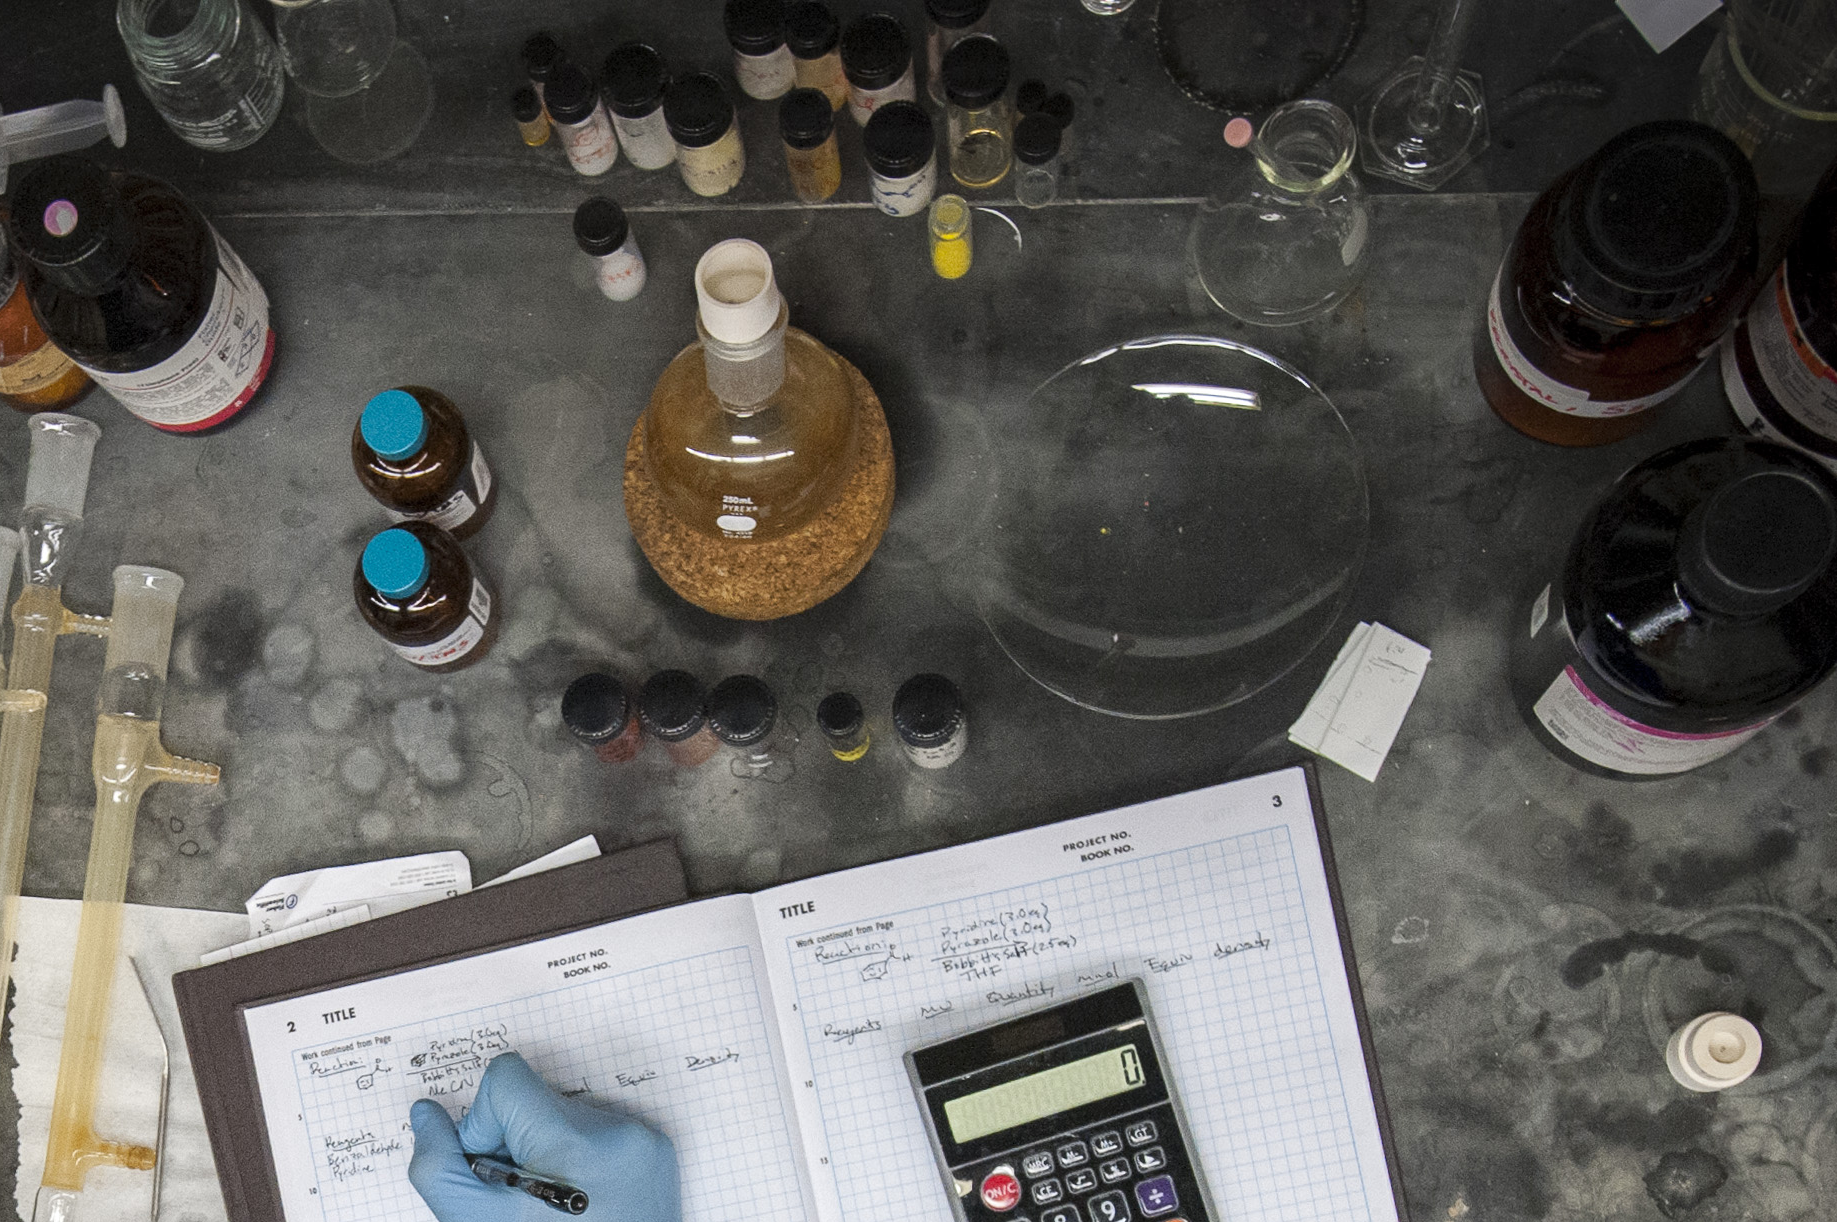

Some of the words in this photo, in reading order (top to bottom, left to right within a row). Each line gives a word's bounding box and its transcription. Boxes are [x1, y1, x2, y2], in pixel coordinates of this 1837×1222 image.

[1272, 795, 1283, 808] 3
[1062, 835, 1107, 852] PROJECT
[1110, 830, 1132, 842] NO.
[1080, 848, 1111, 863] BOOK
[1114, 844, 1135, 856] NO.
[779, 901, 816, 920] TITLE
[795, 937, 815, 948] Work
[816, 928, 854, 944] continued
[855, 924, 874, 936] from
[875, 919, 895, 932] Page
[546, 952, 587, 970] PROJECT
[589, 948, 610, 960] NO.
[563, 966, 592, 980] BOOK
[592, 961, 613, 973] NO.
[321, 1007, 358, 1026] TITLE
[792, 1003, 798, 1012] 5
[286, 1020, 297, 1033] 2
[300, 1050, 320, 1062] Work
[320, 1041, 355, 1058] continued
[356, 1037, 374, 1050] from
[374, 1033, 393, 1048] Page
[804, 1080, 813, 1089] 10
[1100, 1138, 1115, 1149] M+
[1134, 1128, 1149, 1140] GT
[820, 1156, 829, 1165] 15
[308, 1187, 318, 1195] 10
[983, 1181, 1018, 1201] ON/C
[1100, 1200, 1117, 1222] 9
